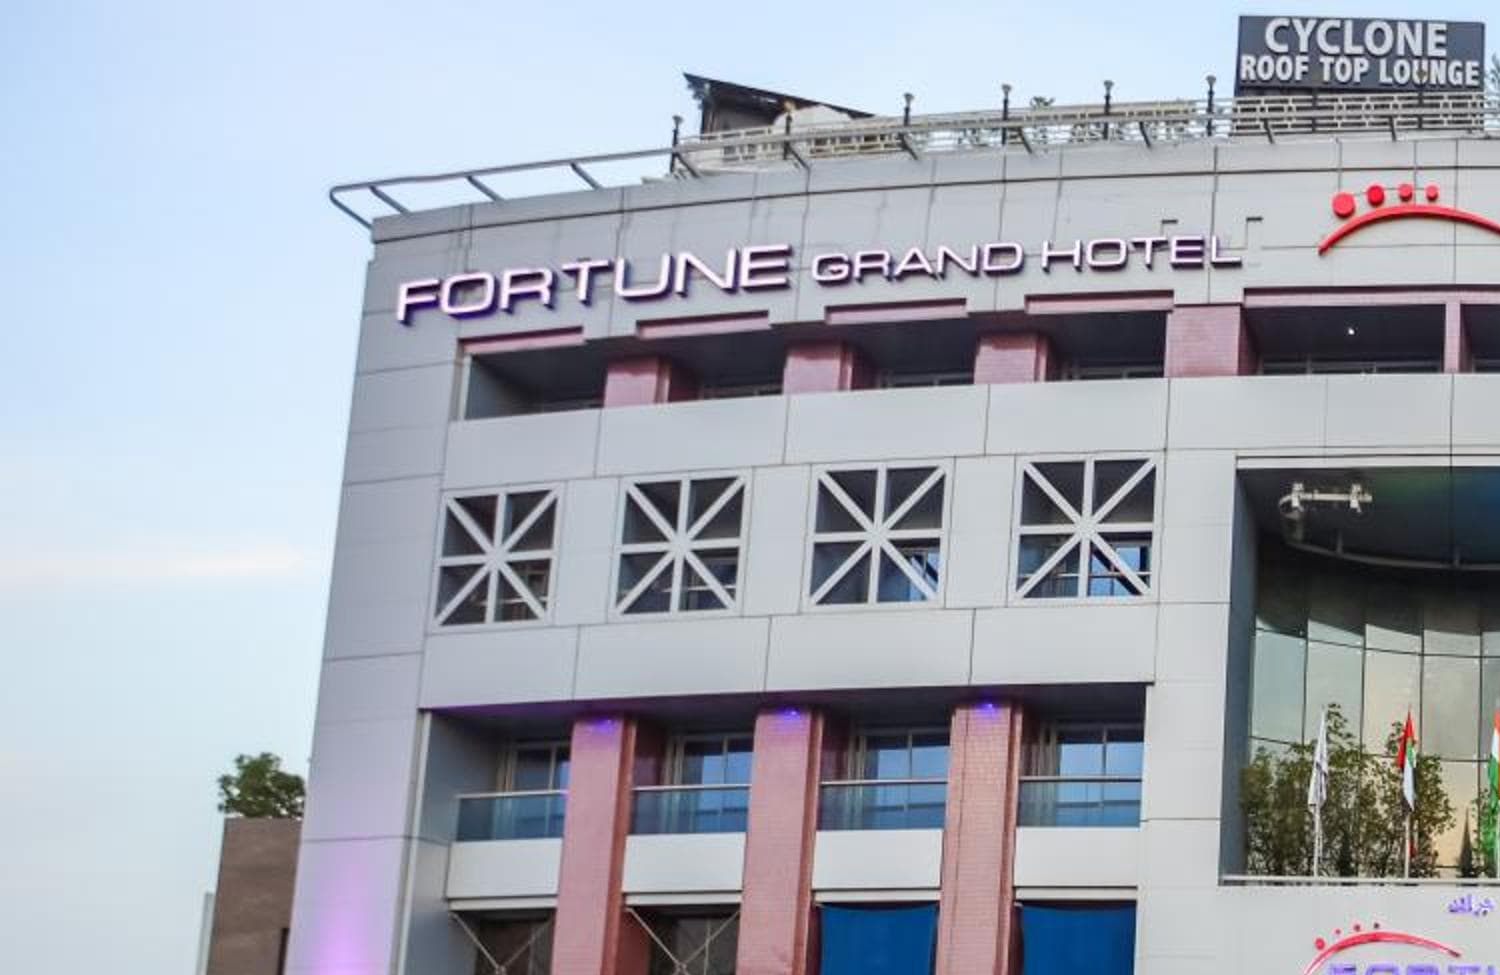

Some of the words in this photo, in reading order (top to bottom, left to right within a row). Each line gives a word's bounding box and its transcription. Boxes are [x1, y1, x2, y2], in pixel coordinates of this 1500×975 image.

[1265, 17, 1448, 57] CYCLONE
[1240, 54, 1310, 82] ROOF
[1319, 57, 1369, 84] TOP
[1379, 58, 1480, 87] LOUNGE
[397, 243, 792, 325] FORTUNE
[811, 241, 1024, 286] GRAND
[1040, 234, 1242, 273] HOTEL
